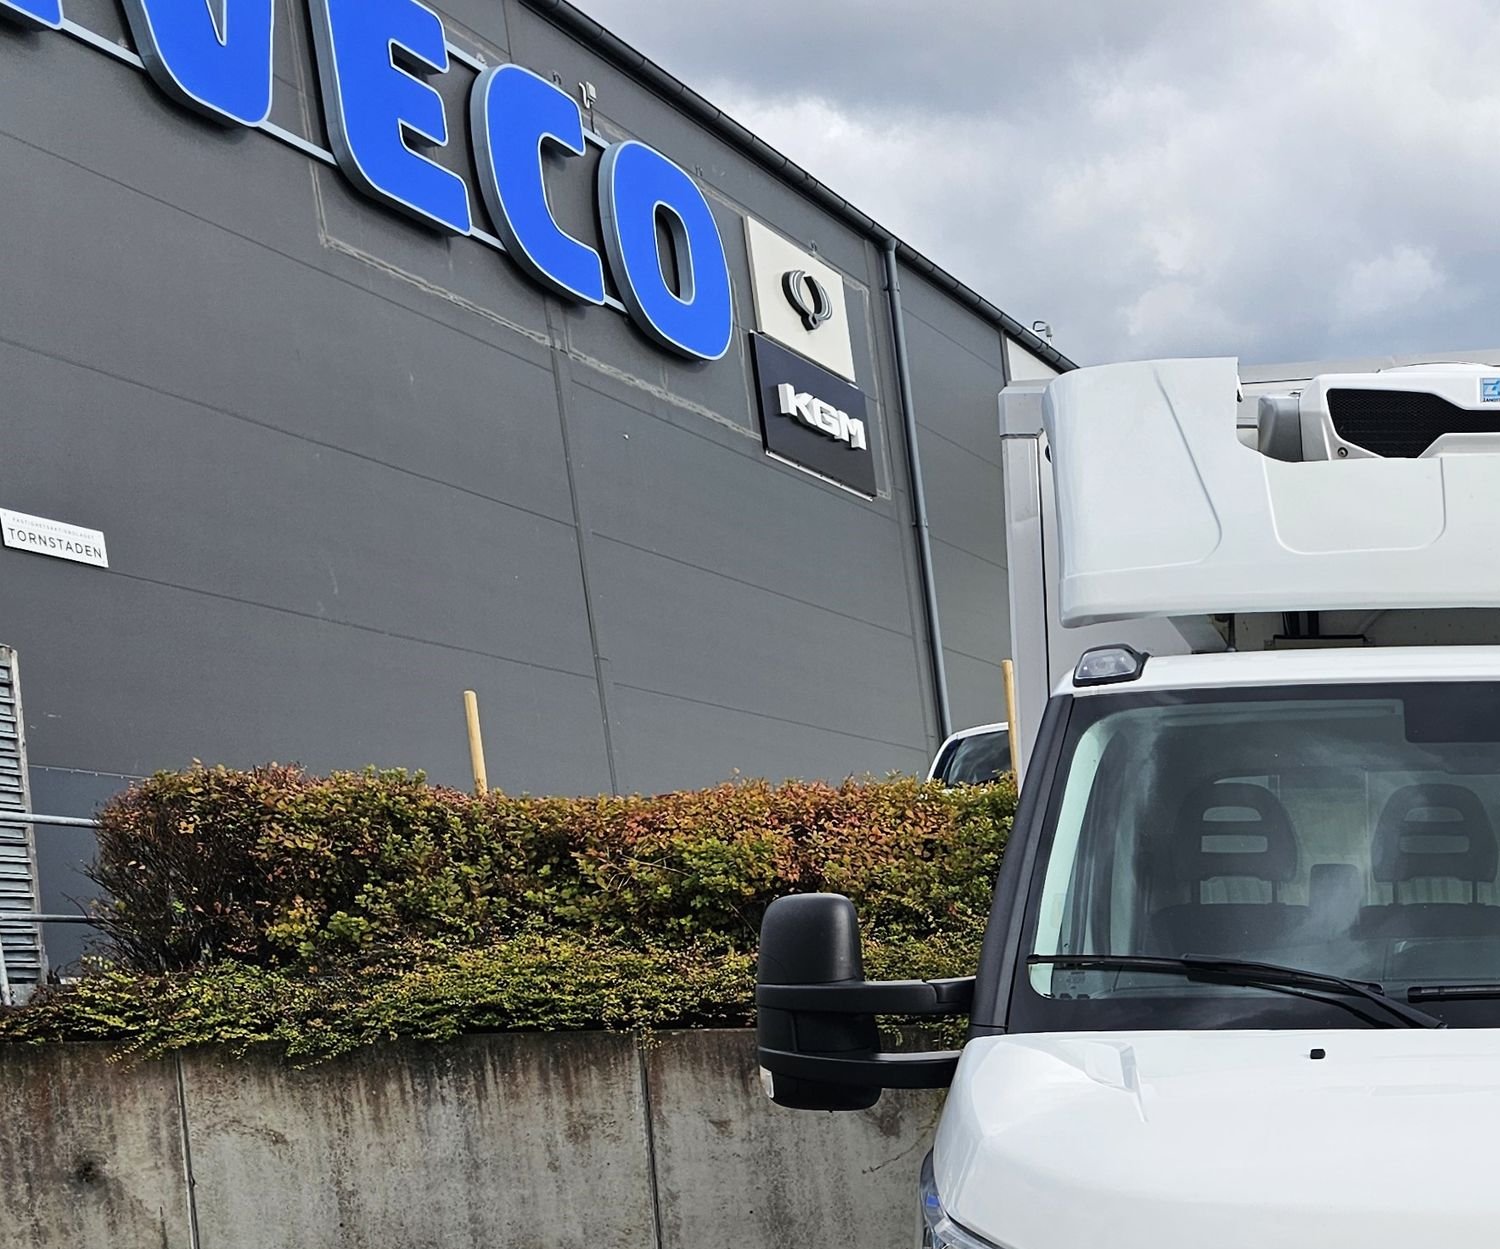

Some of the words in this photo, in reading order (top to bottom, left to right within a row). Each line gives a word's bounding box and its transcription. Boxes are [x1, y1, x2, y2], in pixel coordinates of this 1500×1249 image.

[0, 0, 733, 362] VECO
[778, 383, 867, 450] KGM
[8, 527, 103, 559] TORNSTADEN
